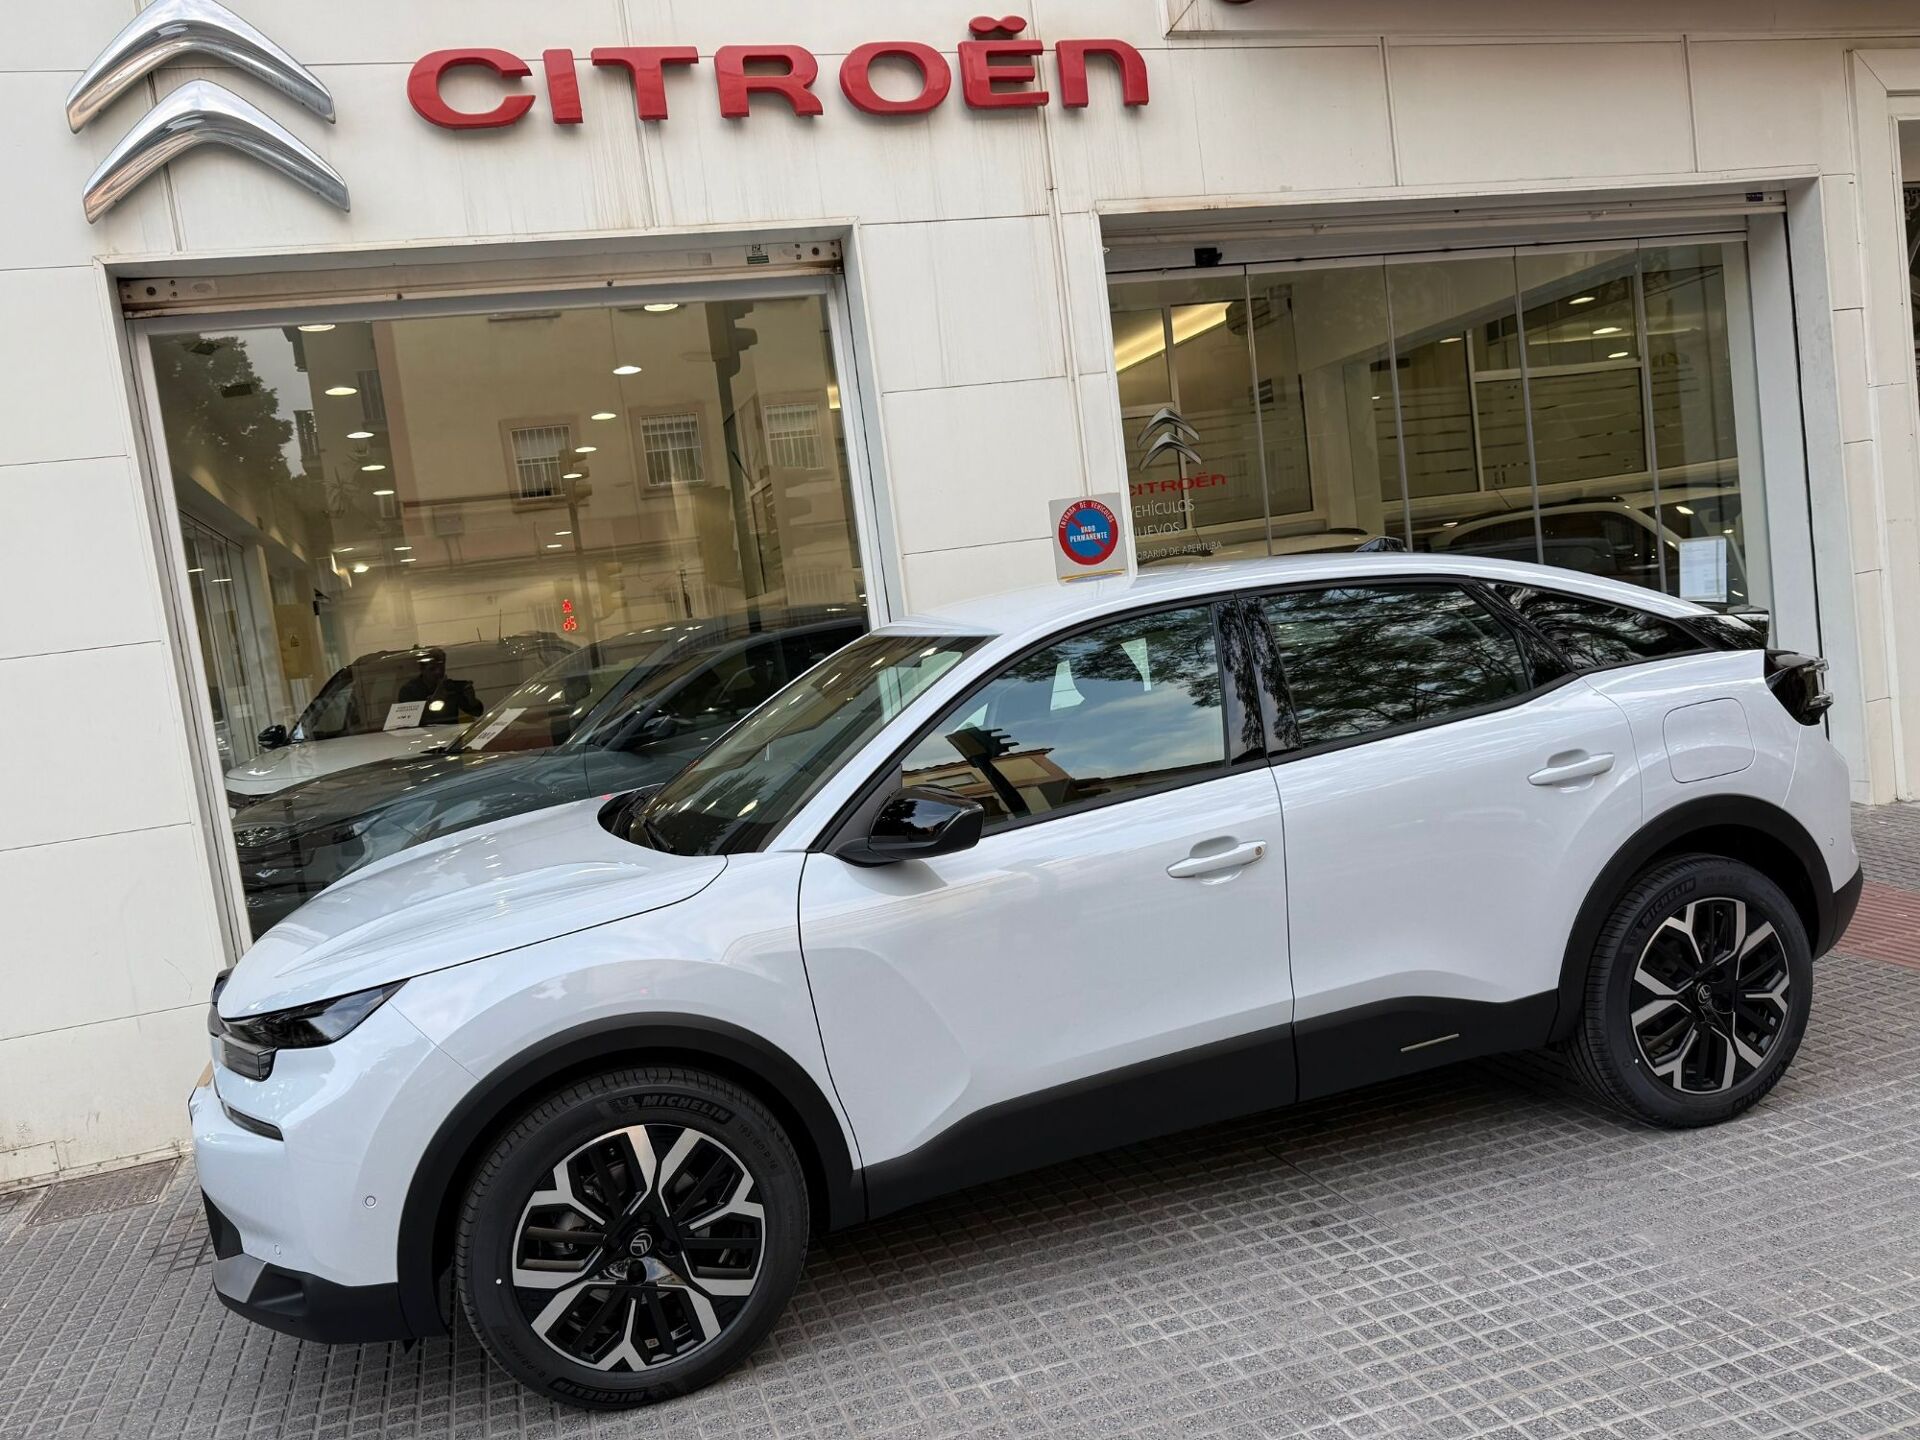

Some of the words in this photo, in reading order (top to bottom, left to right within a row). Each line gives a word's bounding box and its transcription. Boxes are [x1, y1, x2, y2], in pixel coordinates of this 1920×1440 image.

[407, 15, 1149, 130] CITROËN
[1069, 531, 1108, 543] PERMANENTE
[1081, 525, 1096, 534] VADO
[1136, 547, 1167, 561] ORARIO
[1169, 546, 1180, 556] DE
[1182, 540, 1223, 554] APERTURA
[641, 1095, 732, 1121] MICHELIN
[552, 1380, 646, 1401] MICHELIN
